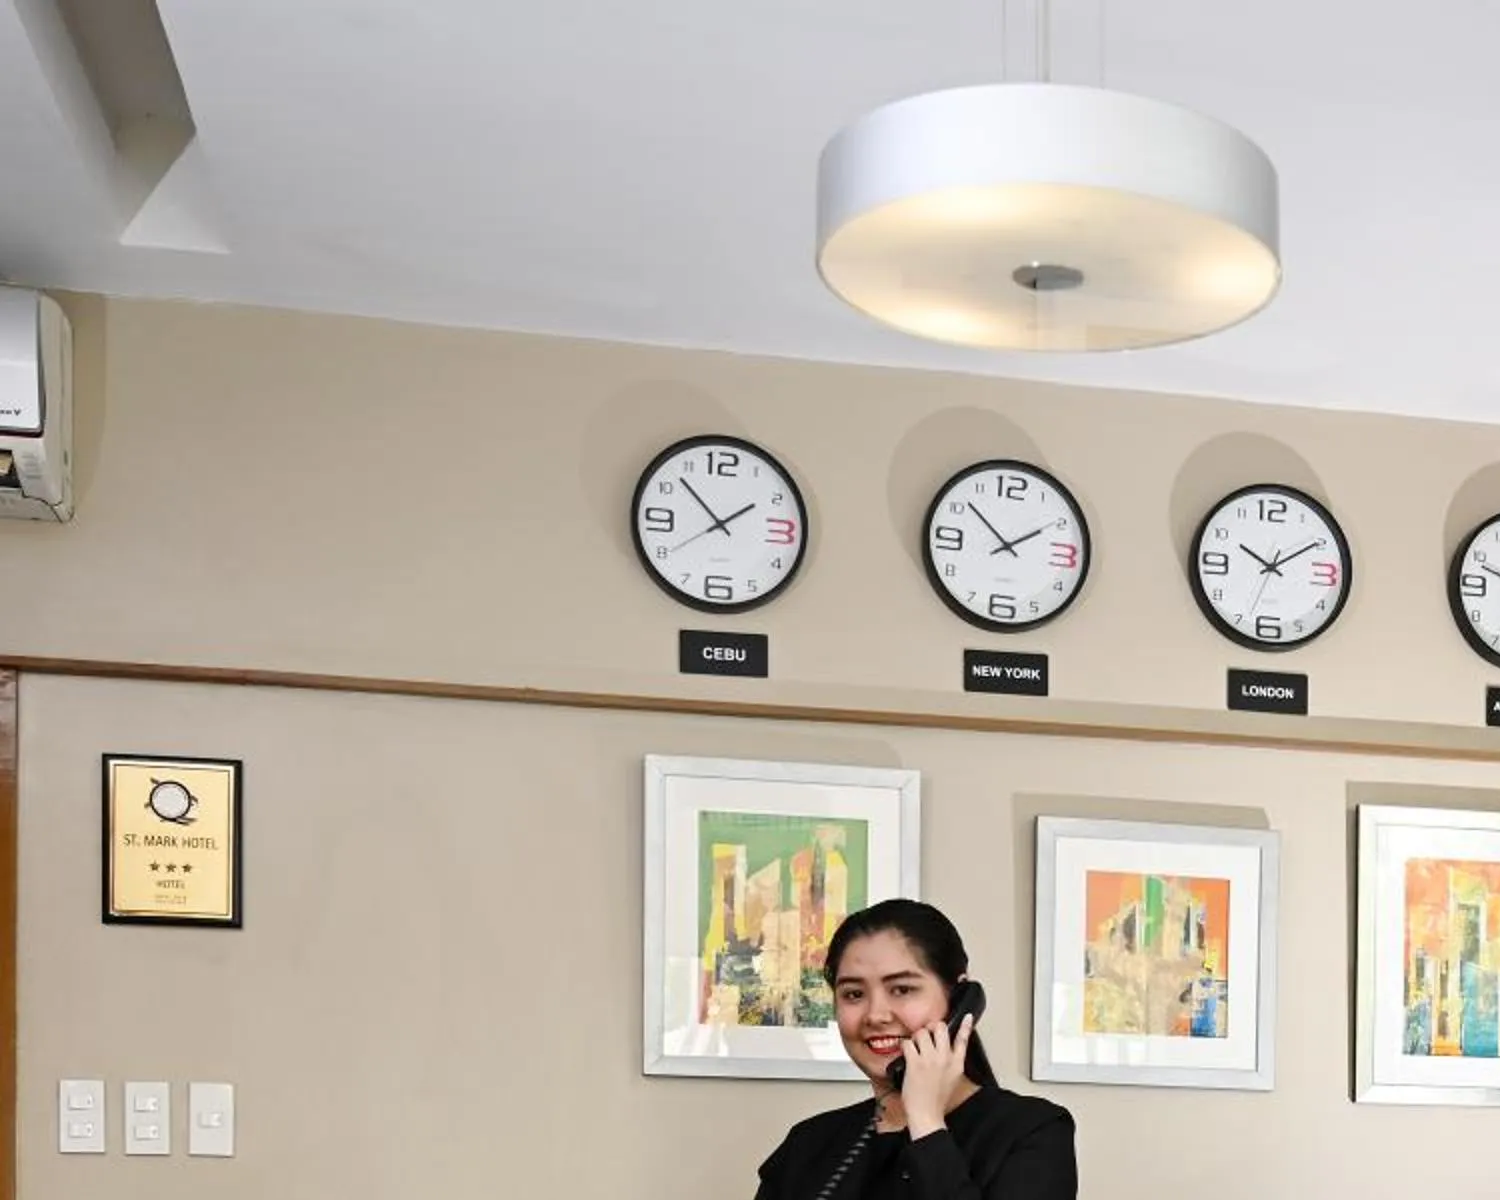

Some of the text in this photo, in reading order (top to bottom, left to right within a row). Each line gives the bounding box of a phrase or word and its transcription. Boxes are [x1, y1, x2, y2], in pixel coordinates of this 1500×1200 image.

[706, 451, 739, 477] 12
[996, 475, 1028, 501] 12
[645, 507, 674, 532] 9
[1257, 500, 1287, 523] 12
[765, 518, 795, 545] 3
[935, 525, 963, 551] 9
[1049, 543, 1077, 568] 3
[1202, 552, 1229, 576] 9
[1309, 562, 1337, 586] 3
[1462, 574, 1486, 597] 9
[704, 575, 733, 600] 6
[989, 594, 1016, 619] 6
[1255, 615, 1281, 639] 6
[702, 646, 746, 662] CEBU
[972, 665, 1040, 681] NEW YORK
[1241, 685, 1294, 699] LONDON
[143, 835, 178, 847] MARK
[181, 837, 219, 850] HOTEL
